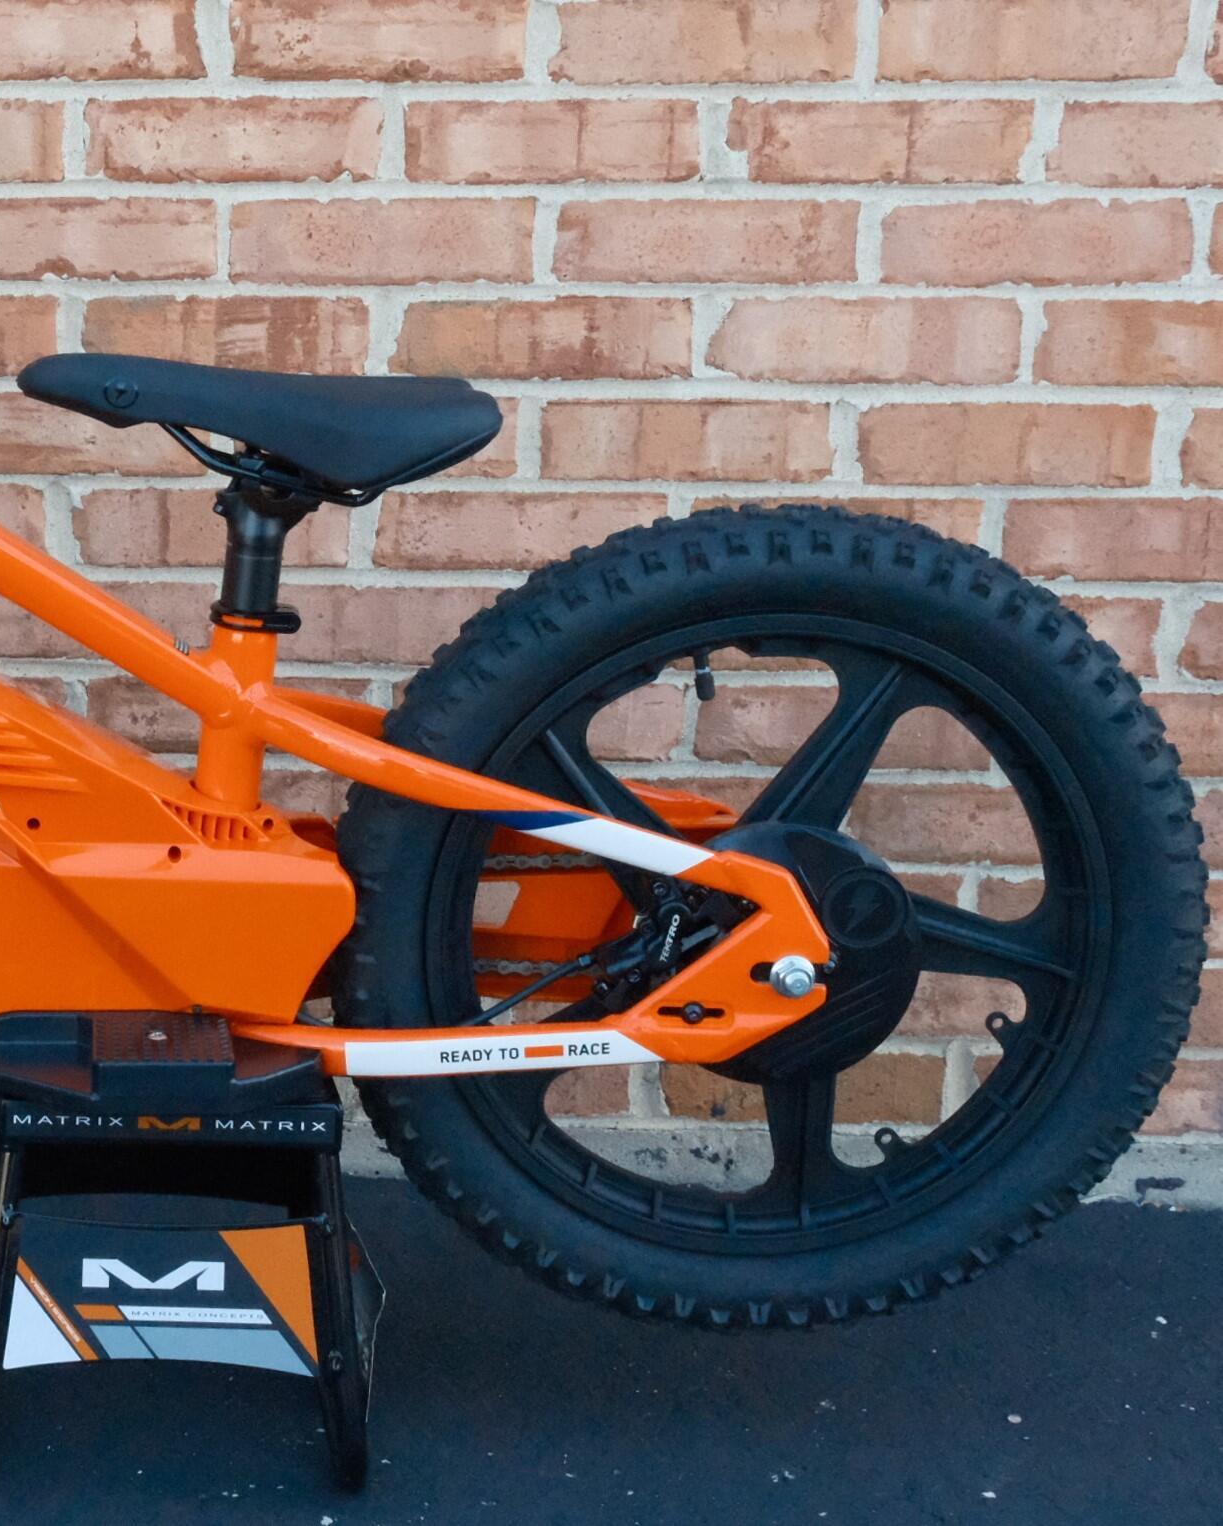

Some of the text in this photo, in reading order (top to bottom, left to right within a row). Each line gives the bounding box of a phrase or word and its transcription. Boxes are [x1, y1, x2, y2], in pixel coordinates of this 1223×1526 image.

[659, 914, 680, 961] TEKTRO
[440, 1043, 610, 1063] READY TO RACE
[13, 1114, 123, 1127] MATRIX
[215, 1119, 326, 1132] MATRIX
[187, 1311, 264, 1320] CONCEPTS
